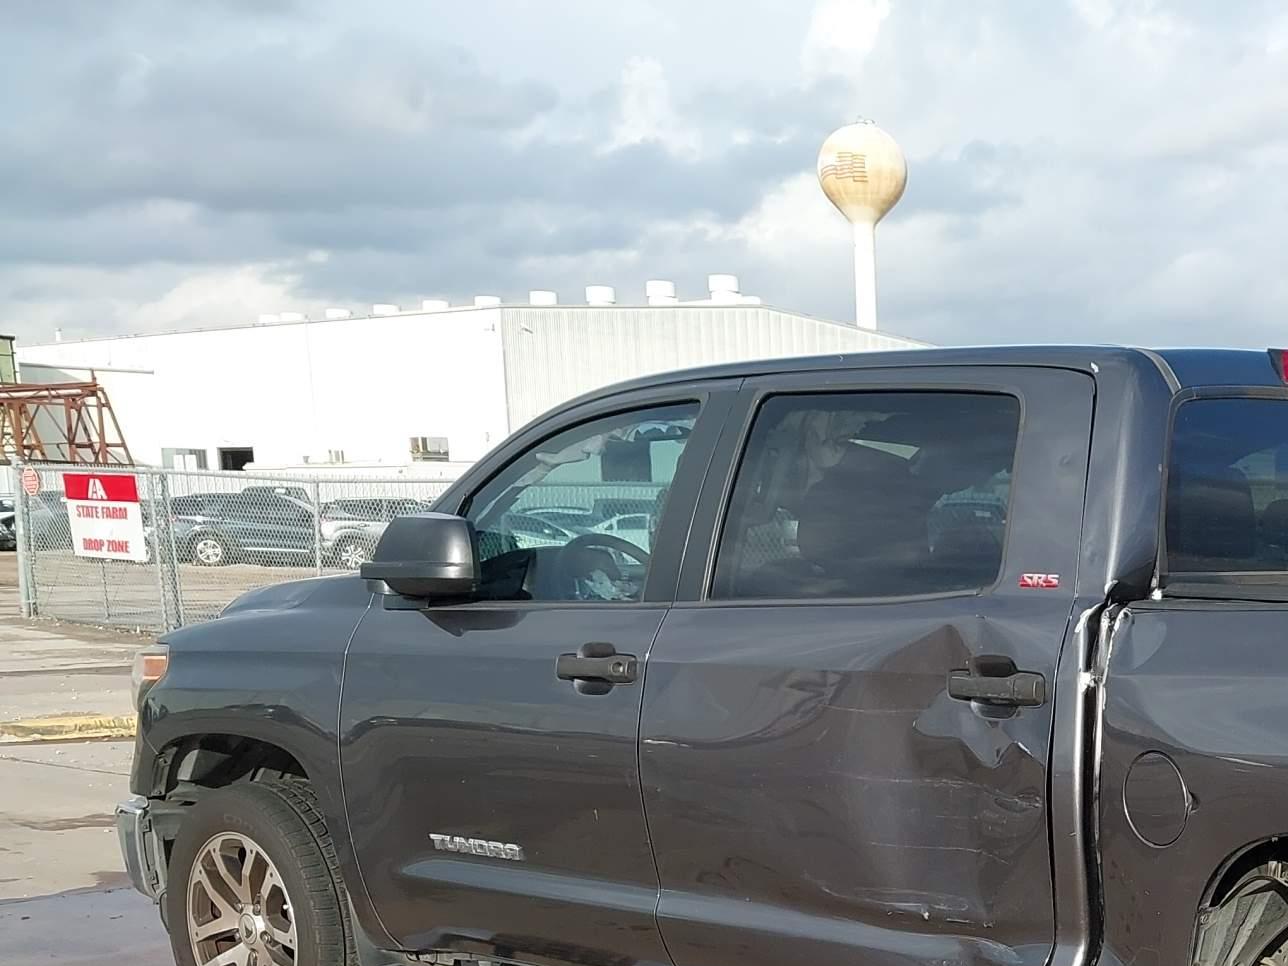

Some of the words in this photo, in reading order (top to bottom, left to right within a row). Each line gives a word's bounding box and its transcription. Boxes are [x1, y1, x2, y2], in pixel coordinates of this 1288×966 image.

[76, 505, 99, 519] STATE
[102, 506, 128, 520] FARM
[82, 538, 105, 552] DROP
[106, 539, 130, 554] ZONE
[428, 833, 524, 861] TUNDRA
